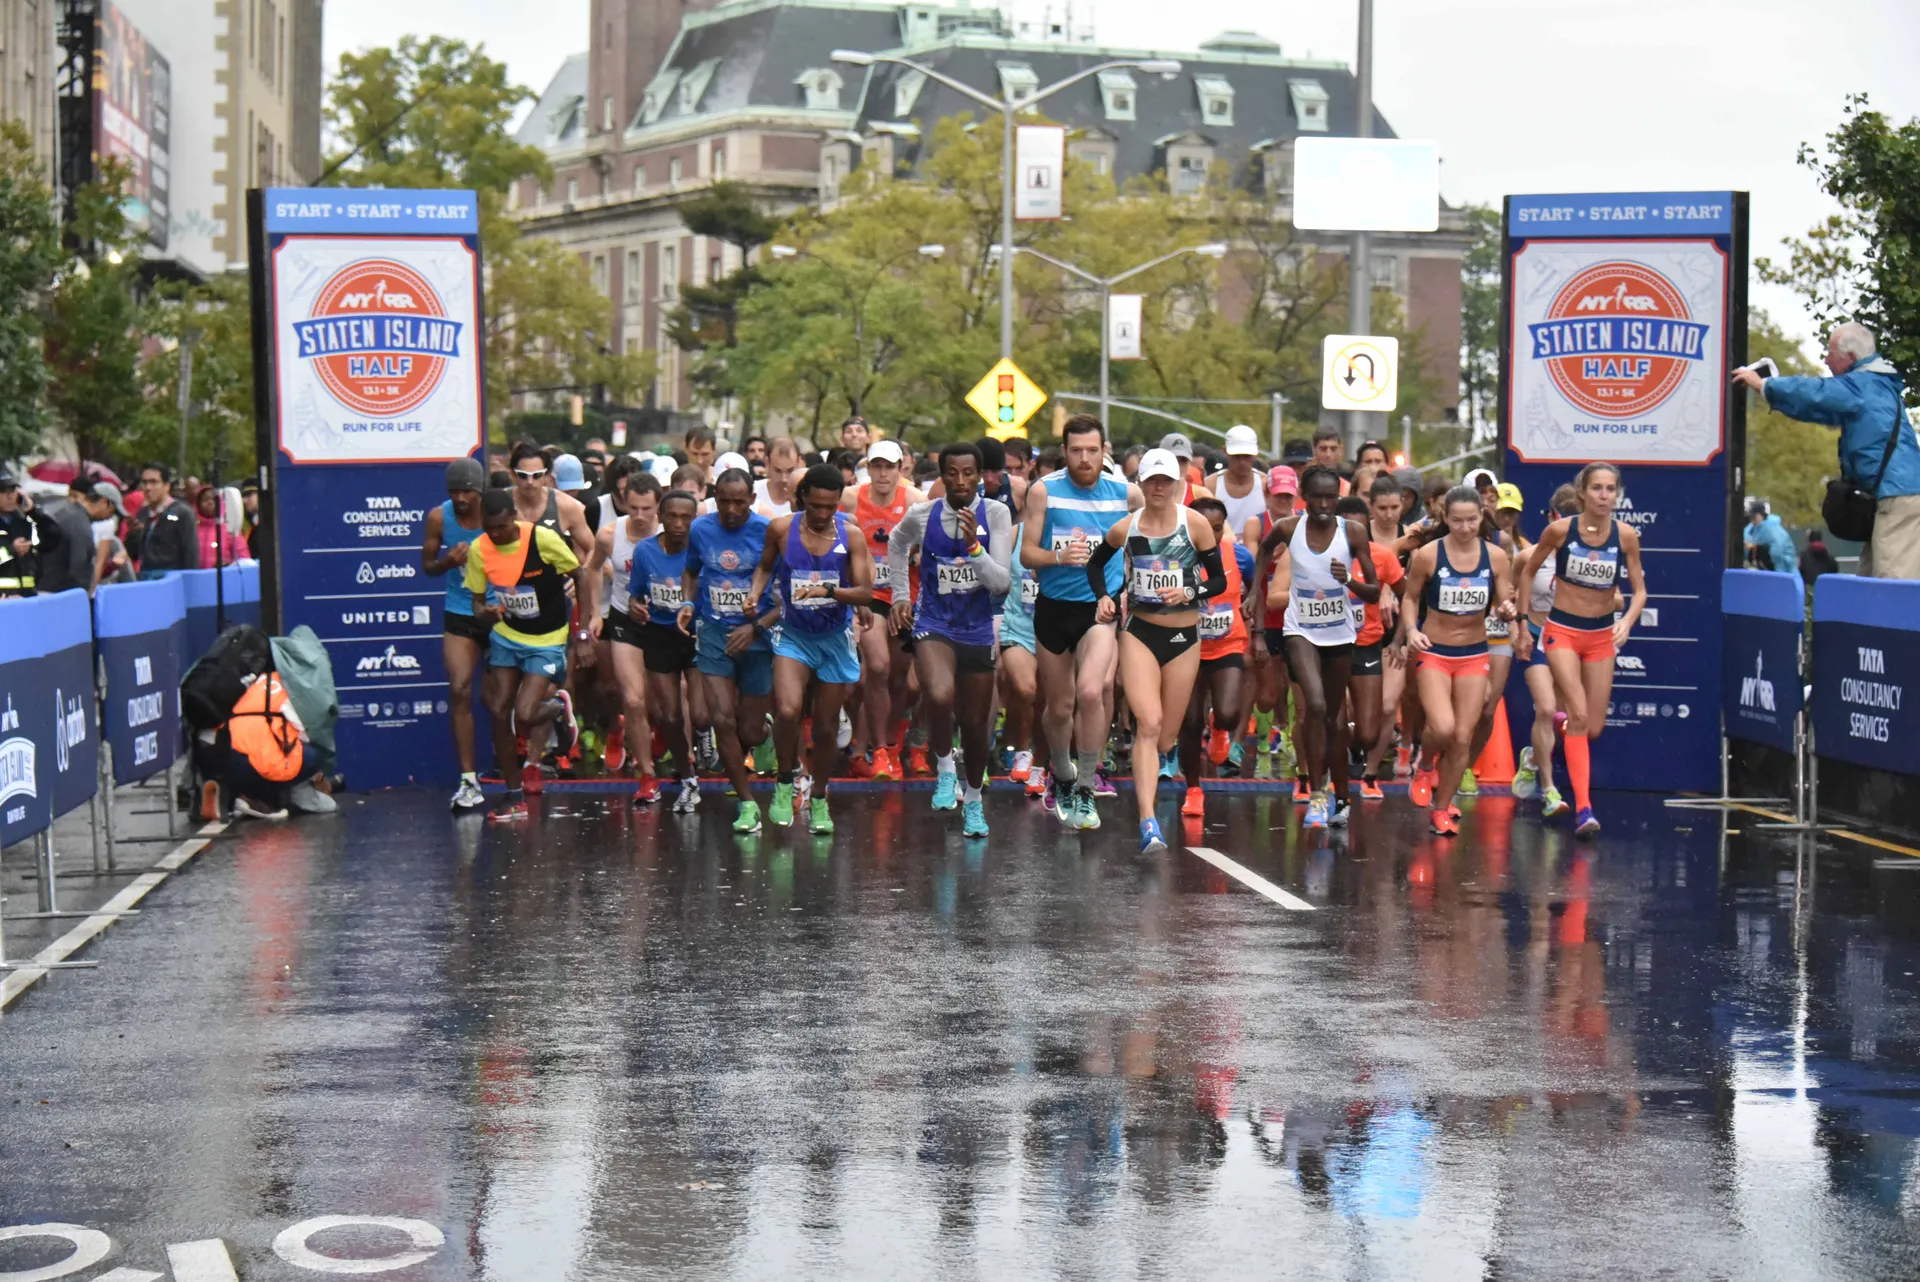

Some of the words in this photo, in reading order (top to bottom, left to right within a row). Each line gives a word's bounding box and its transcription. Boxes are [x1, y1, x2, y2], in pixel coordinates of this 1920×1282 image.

[276, 203, 332, 218] START
[347, 204, 401, 219] START
[416, 205, 469, 219] START
[1518, 208, 1574, 222] START
[1590, 206, 1647, 221] START
[1663, 205, 1722, 220] START
[301, 319, 376, 354] STATEN
[384, 319, 455, 353] ISLAND
[1536, 321, 1612, 356] STATEN
[1622, 321, 1700, 355] ISLAND
[349, 356, 413, 378] HALF
[1583, 358, 1652, 379] HALF
[343, 422, 367, 433] RUN
[371, 422, 394, 432] FOR
[397, 422, 422, 432] LIFE
[1573, 424, 1599, 433] RUN
[1603, 424, 1628, 433] FOR
[1632, 424, 1658, 434] LIFE
[365, 496, 402, 509] TATA
[343, 510, 424, 523] CONSULTANCY
[358, 524, 411, 537] SERVICES
[375, 564, 416, 578] airbnb
[939, 569, 947, 580] A
[1578, 561, 1613, 579] 18590
[1146, 574, 1178, 590] 7600
[503, 596, 535, 609] 12407
[660, 588, 685, 602] 1240
[1451, 591, 1485, 605] 14250
[1308, 600, 1344, 617] 15043
[342, 611, 410, 624] UNITED
[1201, 616, 1230, 629] 12414
[1858, 647, 1885, 674] TATA
[1841, 677, 1902, 710] CONSULTANCY
[1849, 712, 1890, 743] SERVICES
